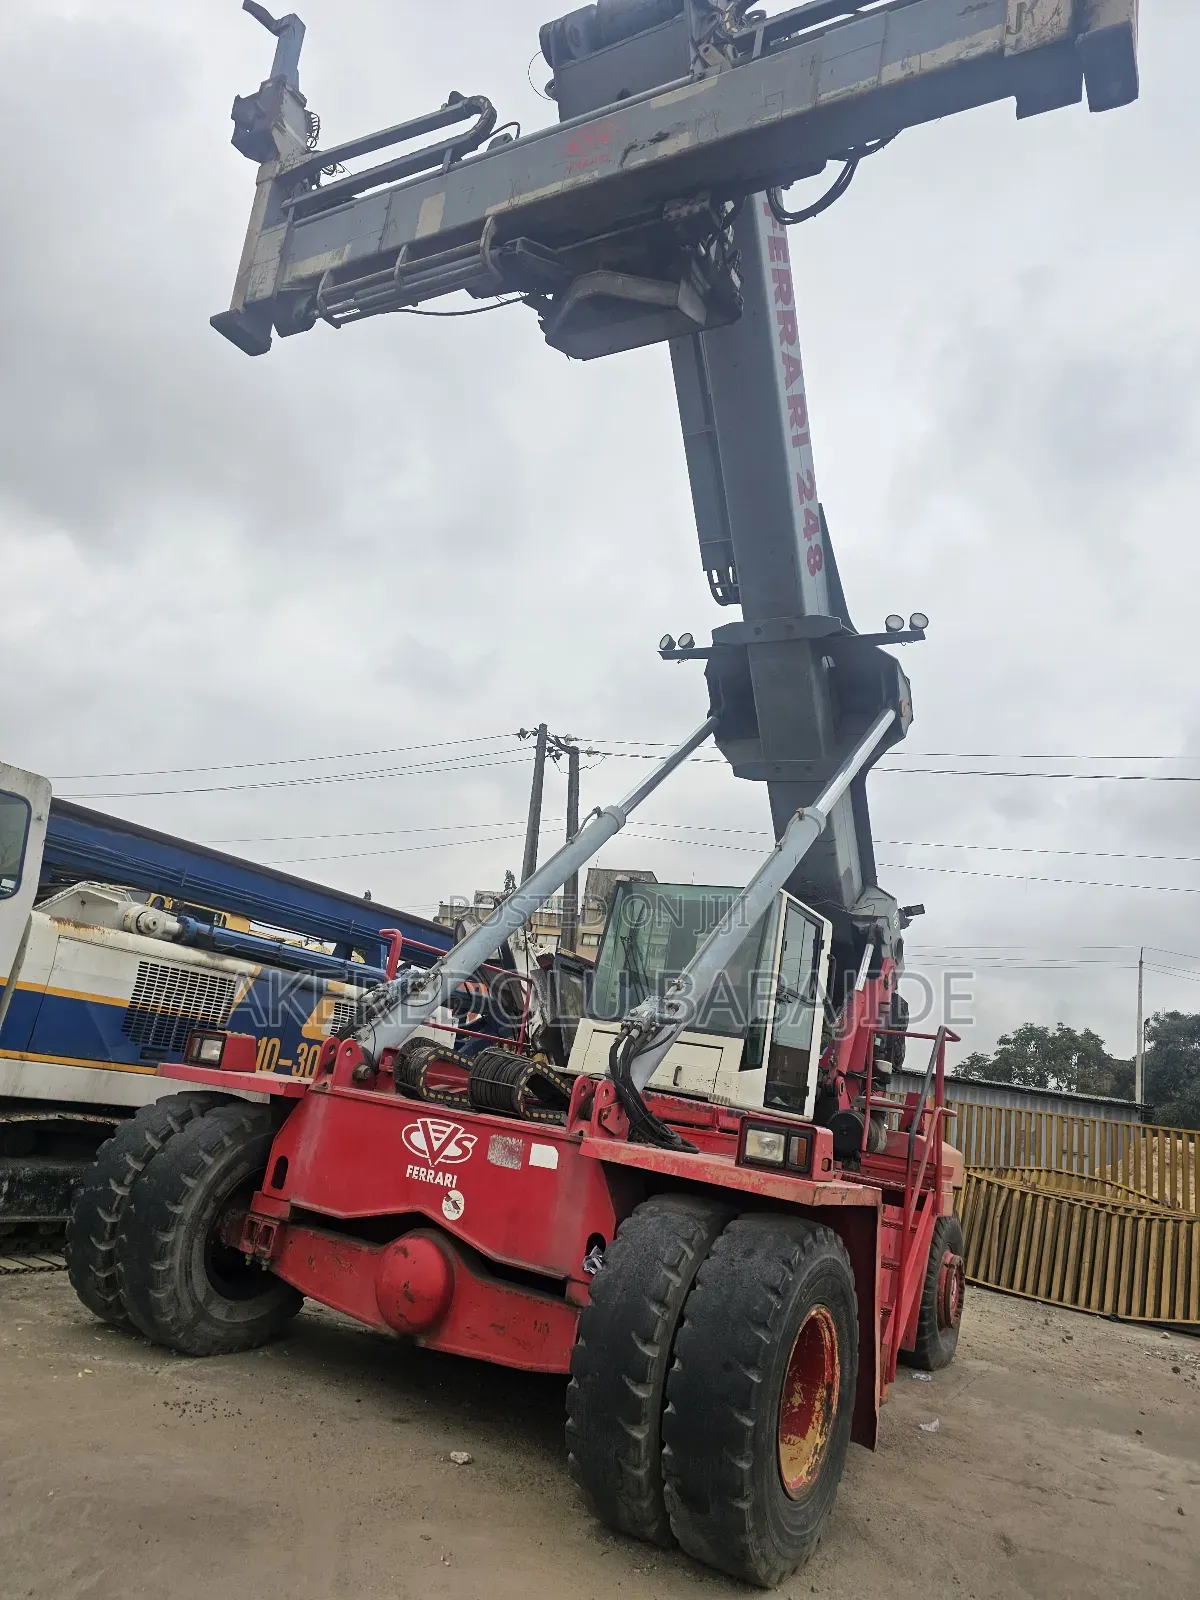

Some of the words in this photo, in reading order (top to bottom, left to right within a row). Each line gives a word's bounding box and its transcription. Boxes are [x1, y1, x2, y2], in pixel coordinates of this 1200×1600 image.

[796, 469, 824, 578] 248
[402, 1118, 478, 1167] CVS
[406, 1164, 457, 1188] FERRARI
